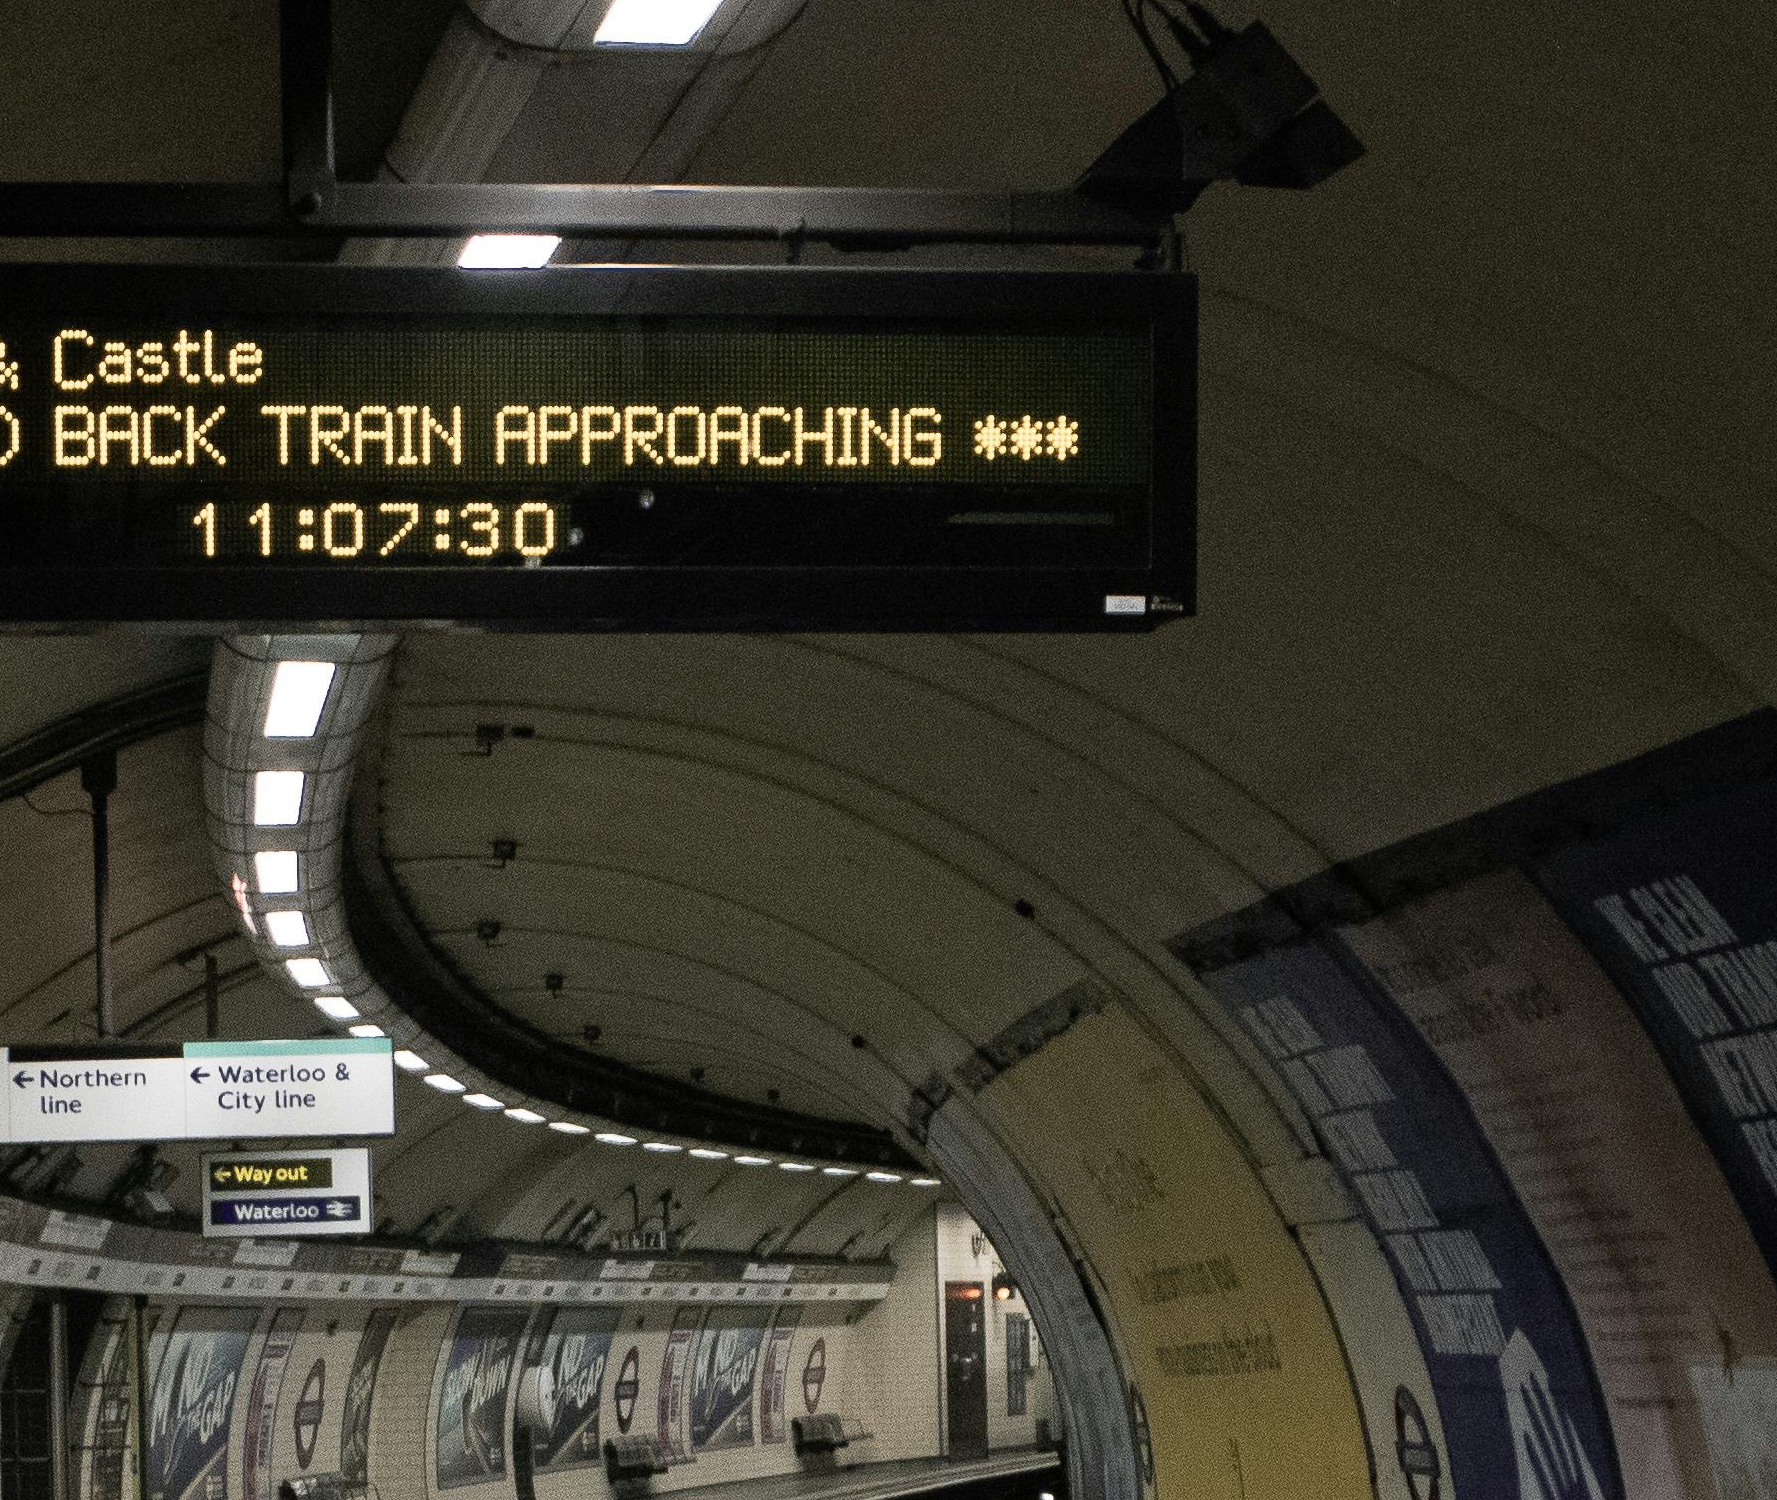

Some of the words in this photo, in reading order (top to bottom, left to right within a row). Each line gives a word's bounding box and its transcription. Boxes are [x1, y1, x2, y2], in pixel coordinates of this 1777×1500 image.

[53, 330, 264, 391] Castle
[54, 405, 226, 466] BACK
[262, 405, 462, 466] TRAIN
[494, 405, 943, 466] APPROACHING
[193, 502, 558, 558] 11:07:30
[40, 1066, 148, 1088] Northern
[218, 1063, 325, 1085] Waterloo
[335, 1063, 350, 1082] &
[40, 1093, 82, 1115] line
[218, 1088, 266, 1114] City
[274, 1088, 316, 1109] line
[234, 1163, 271, 1186] Way
[273, 1163, 308, 1181] out
[234, 1201, 319, 1221] Waterloo
